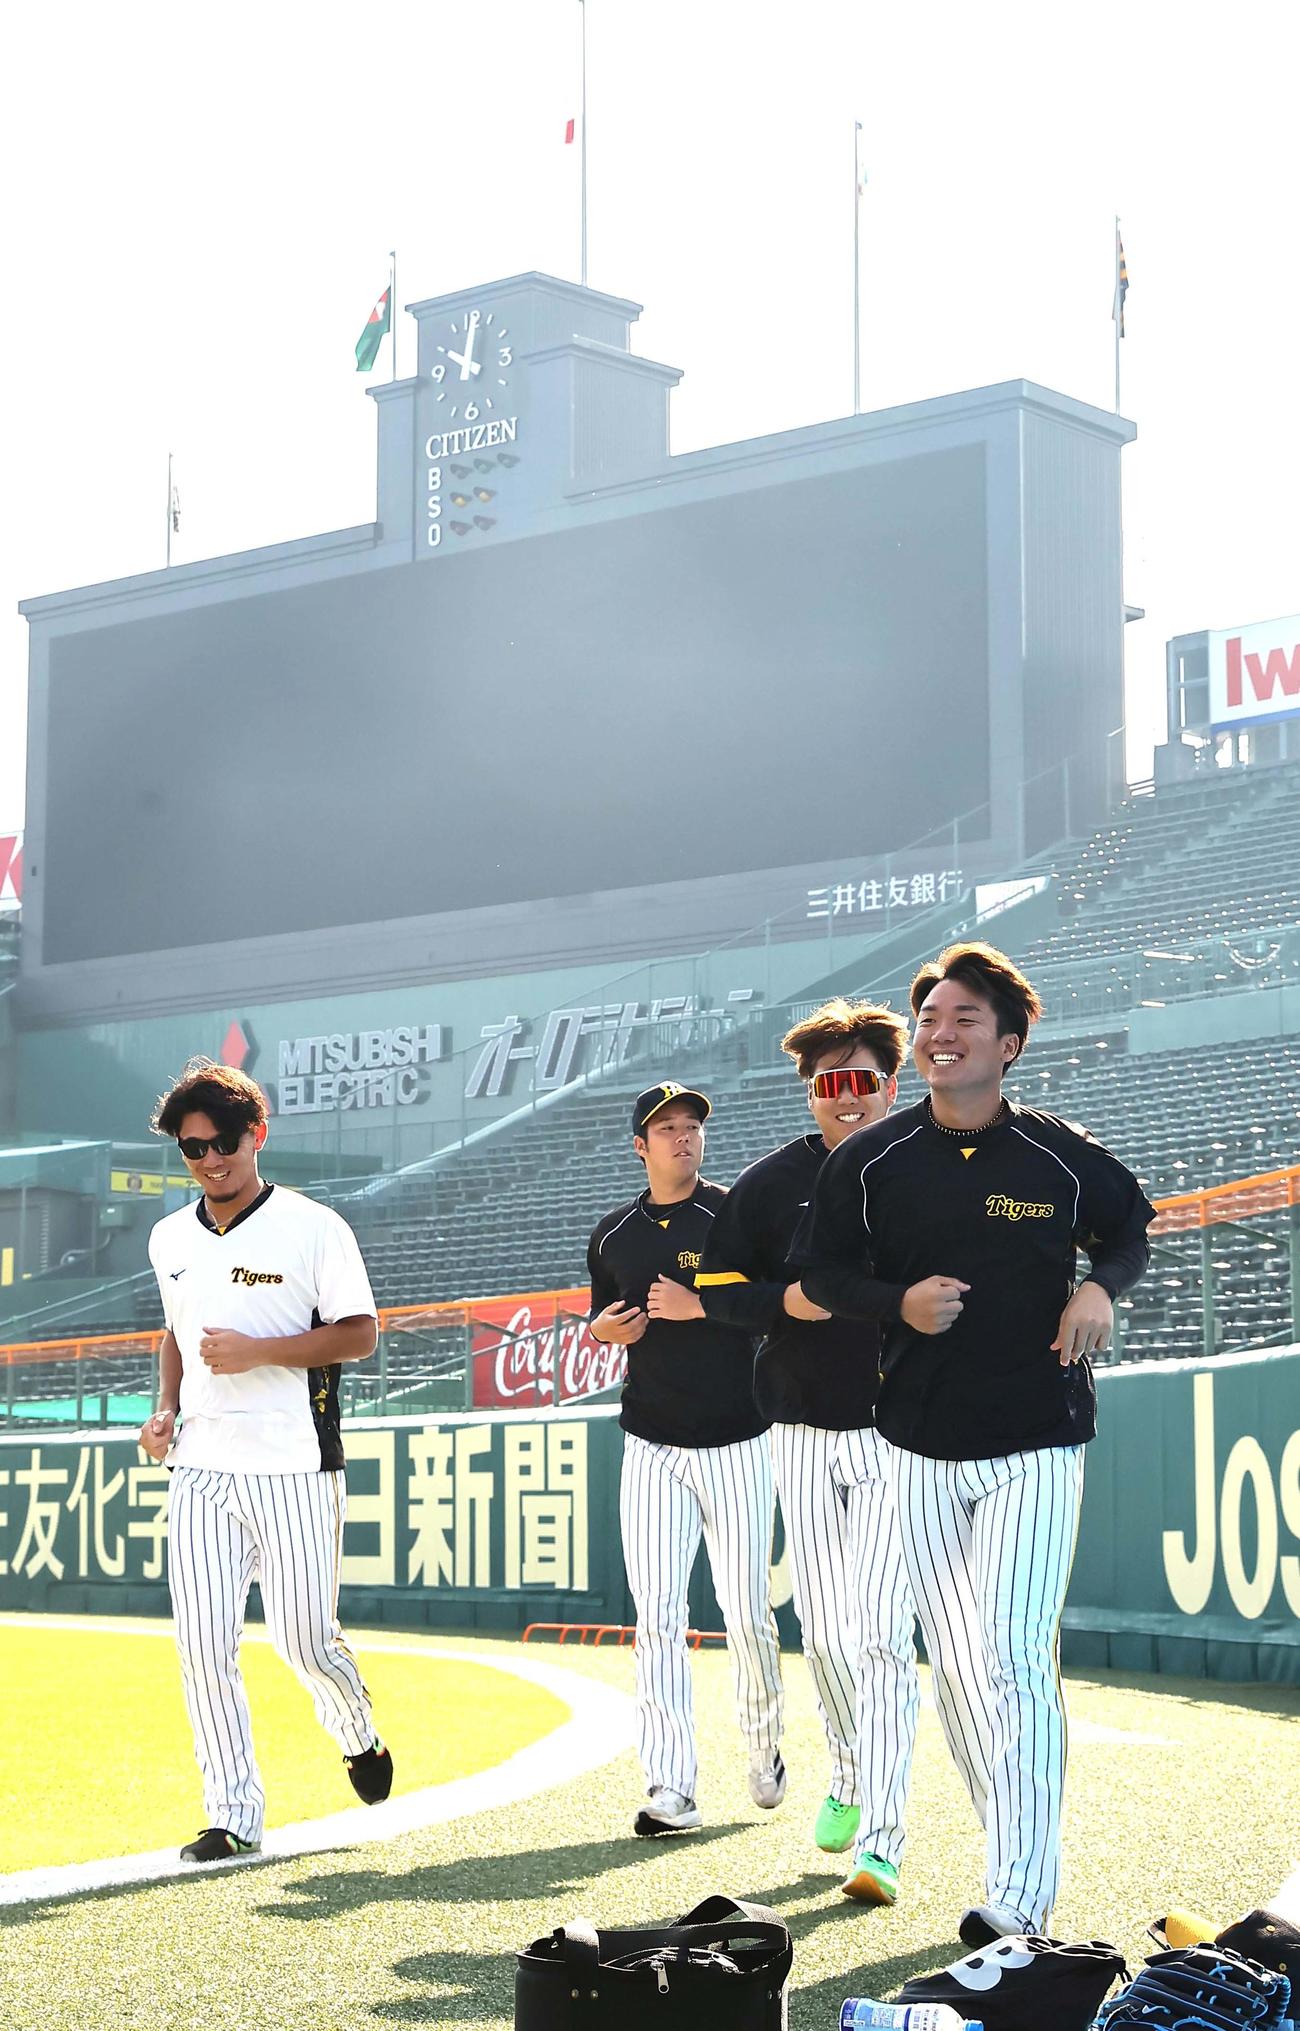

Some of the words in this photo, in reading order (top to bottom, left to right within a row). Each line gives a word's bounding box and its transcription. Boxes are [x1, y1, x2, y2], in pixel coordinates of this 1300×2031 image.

[499, 347, 512, 367] 3
[431, 365, 445, 383] 9
[464, 402, 479, 420] 6
[425, 417, 518, 460] CITIZEN
[428, 466, 442, 491] B
[428, 495, 442, 519] S
[1226, 636, 1300, 707] Iw
[807, 870, 963, 918] 三井住友銀行
[279, 1024, 441, 1076] MITSUBISHI
[278, 1067, 418, 1115] ELECTRIC
[985, 1194, 1055, 1221] Tigers
[231, 1267, 283, 1287] Tigers
[0, 1445, 169, 1580] 友化学
